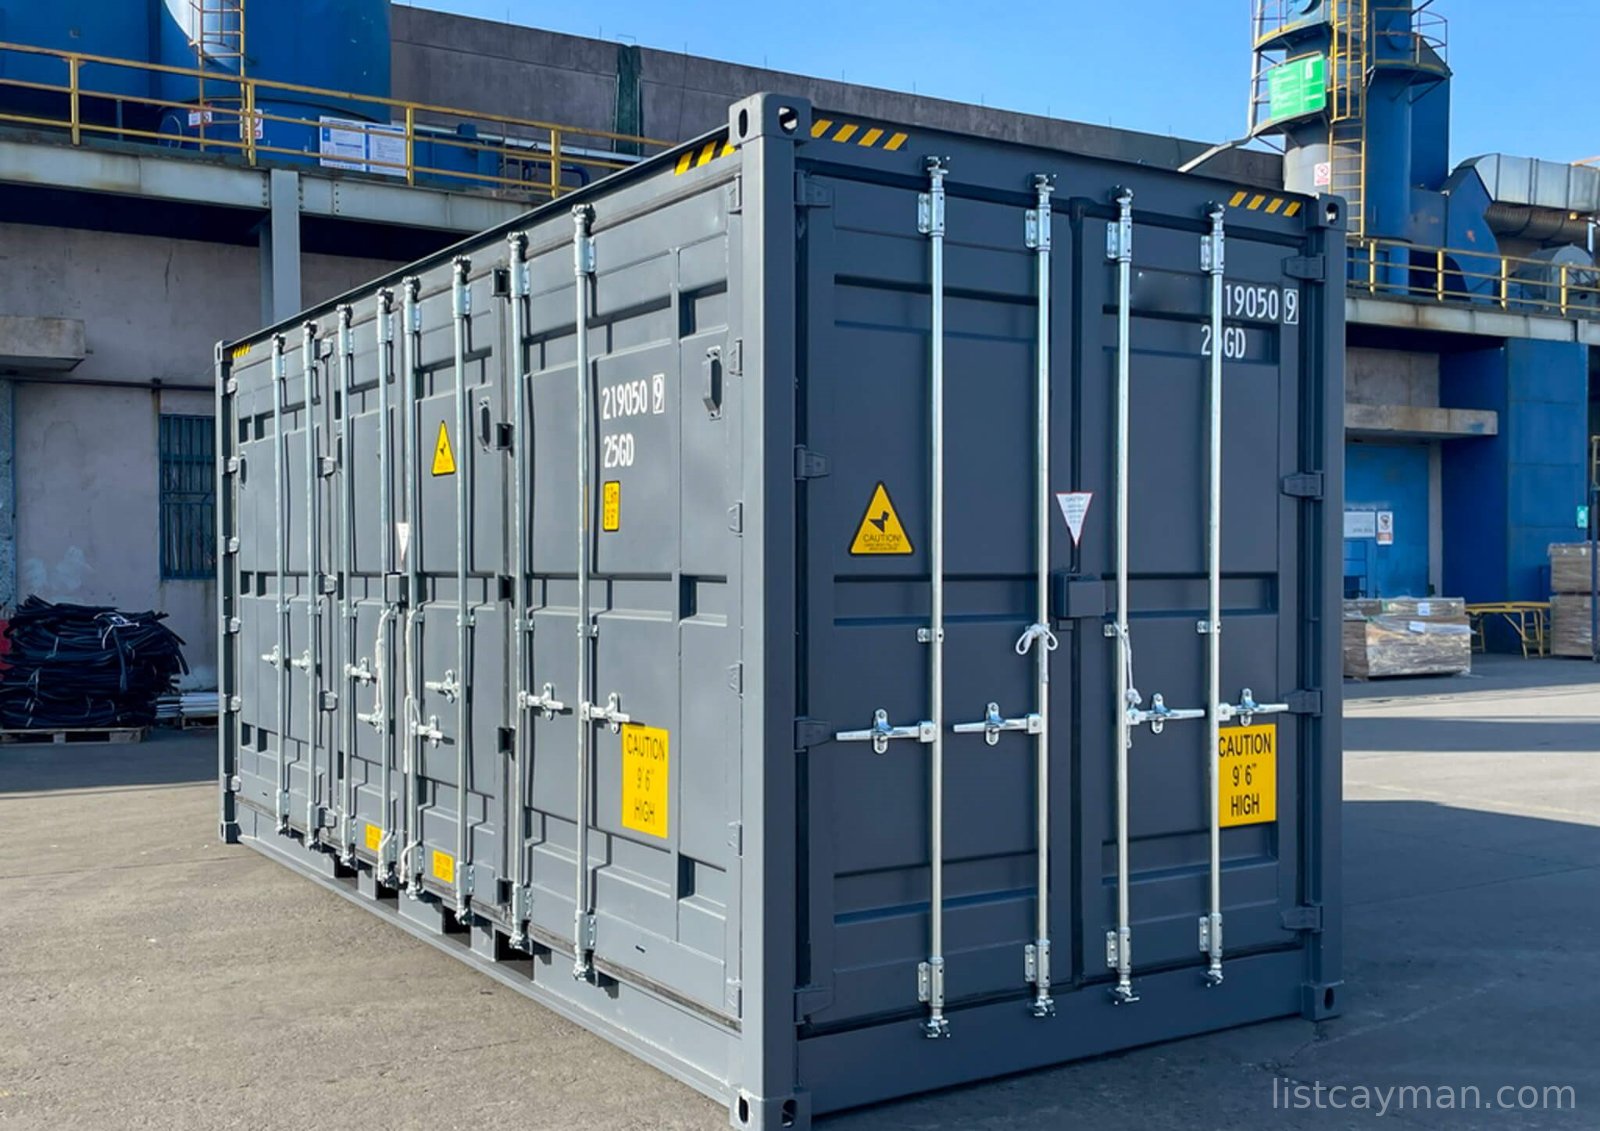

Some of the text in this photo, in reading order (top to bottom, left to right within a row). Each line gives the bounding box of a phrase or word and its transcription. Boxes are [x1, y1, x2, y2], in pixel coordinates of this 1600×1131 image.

[1225, 284, 1297, 322] 19050 9
[1201, 324, 1246, 359] 2GD
[602, 375, 663, 419] 219050 9
[604, 432, 634, 468] 25GD
[626, 732, 665, 761] CAUTION
[1218, 732, 1271, 758] CAUTION
[634, 797, 656, 826] HIGH
[1230, 793, 1260, 817] HIGH
